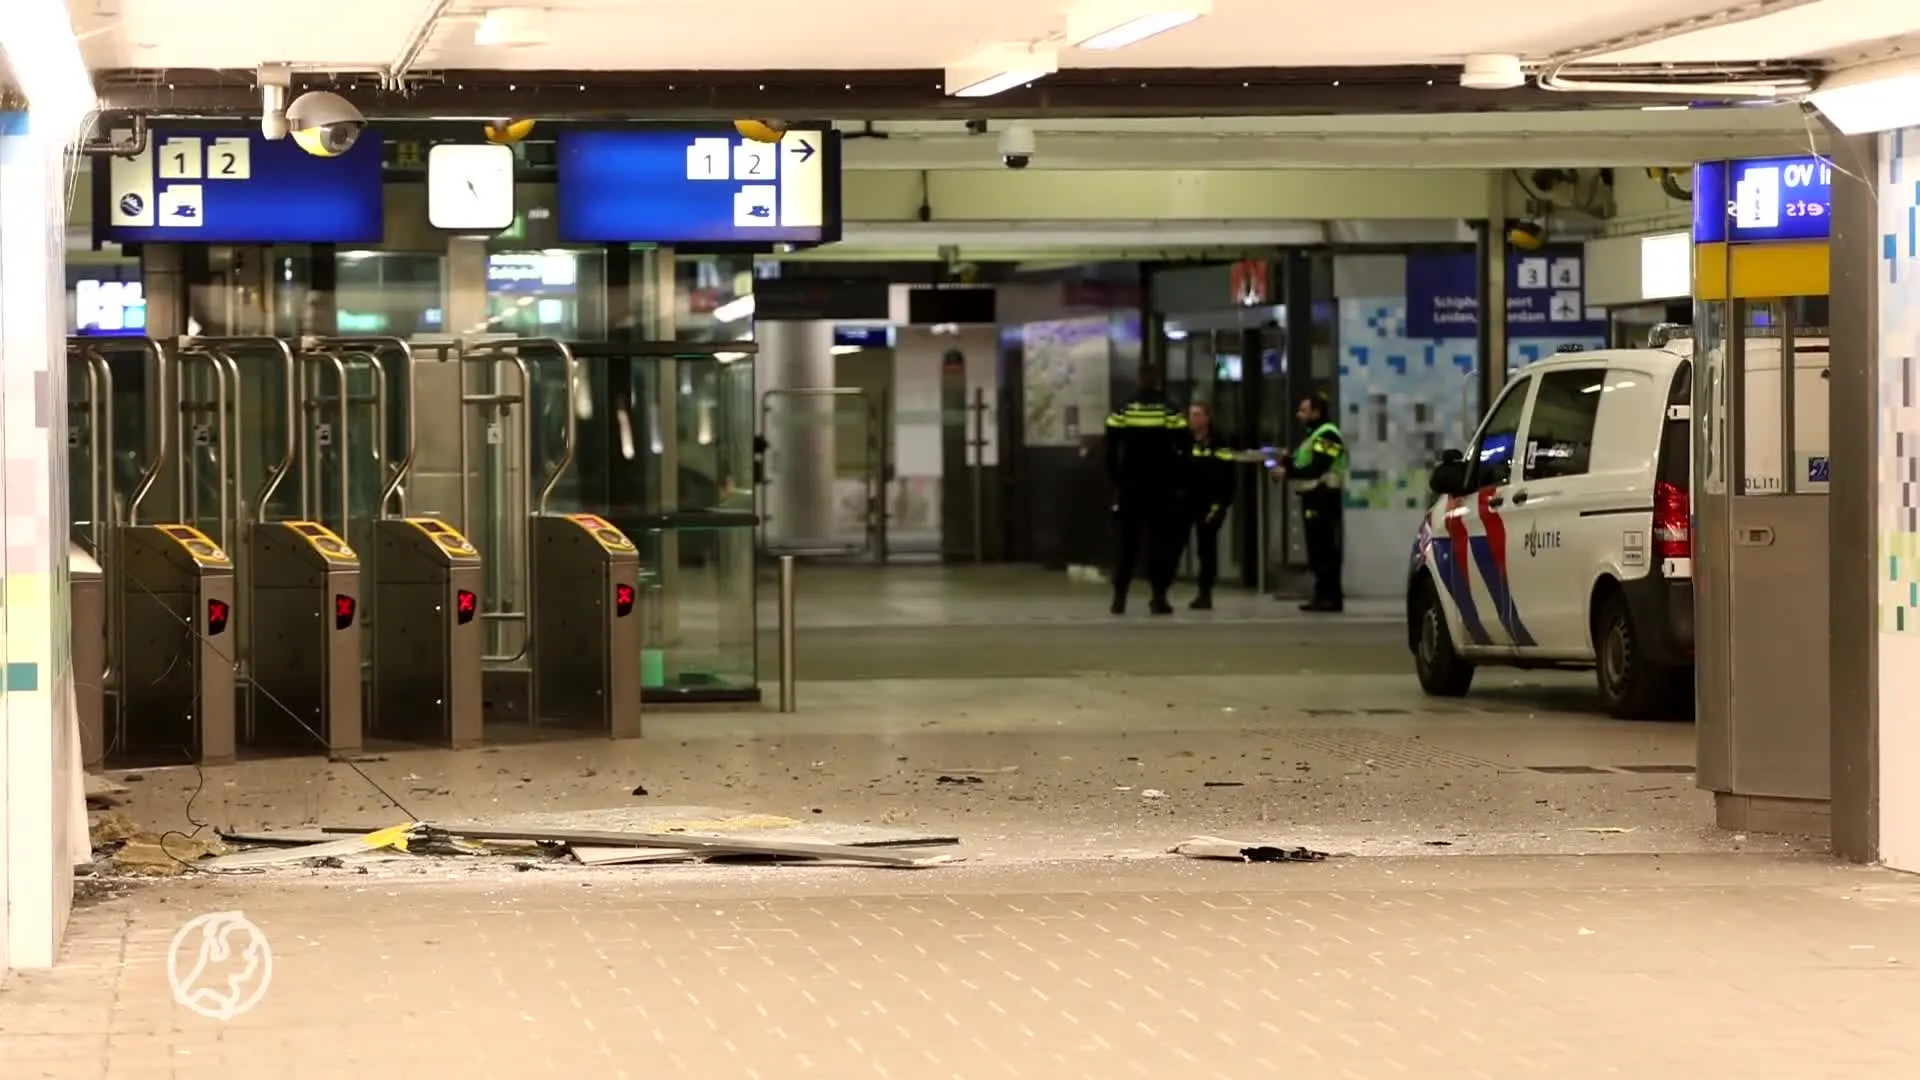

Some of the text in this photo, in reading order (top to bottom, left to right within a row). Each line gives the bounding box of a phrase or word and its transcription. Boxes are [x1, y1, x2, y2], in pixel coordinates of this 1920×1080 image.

[173, 153, 236, 174] 1 2
[703, 154, 761, 175] 1 2
[1784, 163, 1815, 188] OV
[1527, 268, 1571, 285] 3 4
[1744, 478, 1780, 490] OLITI
